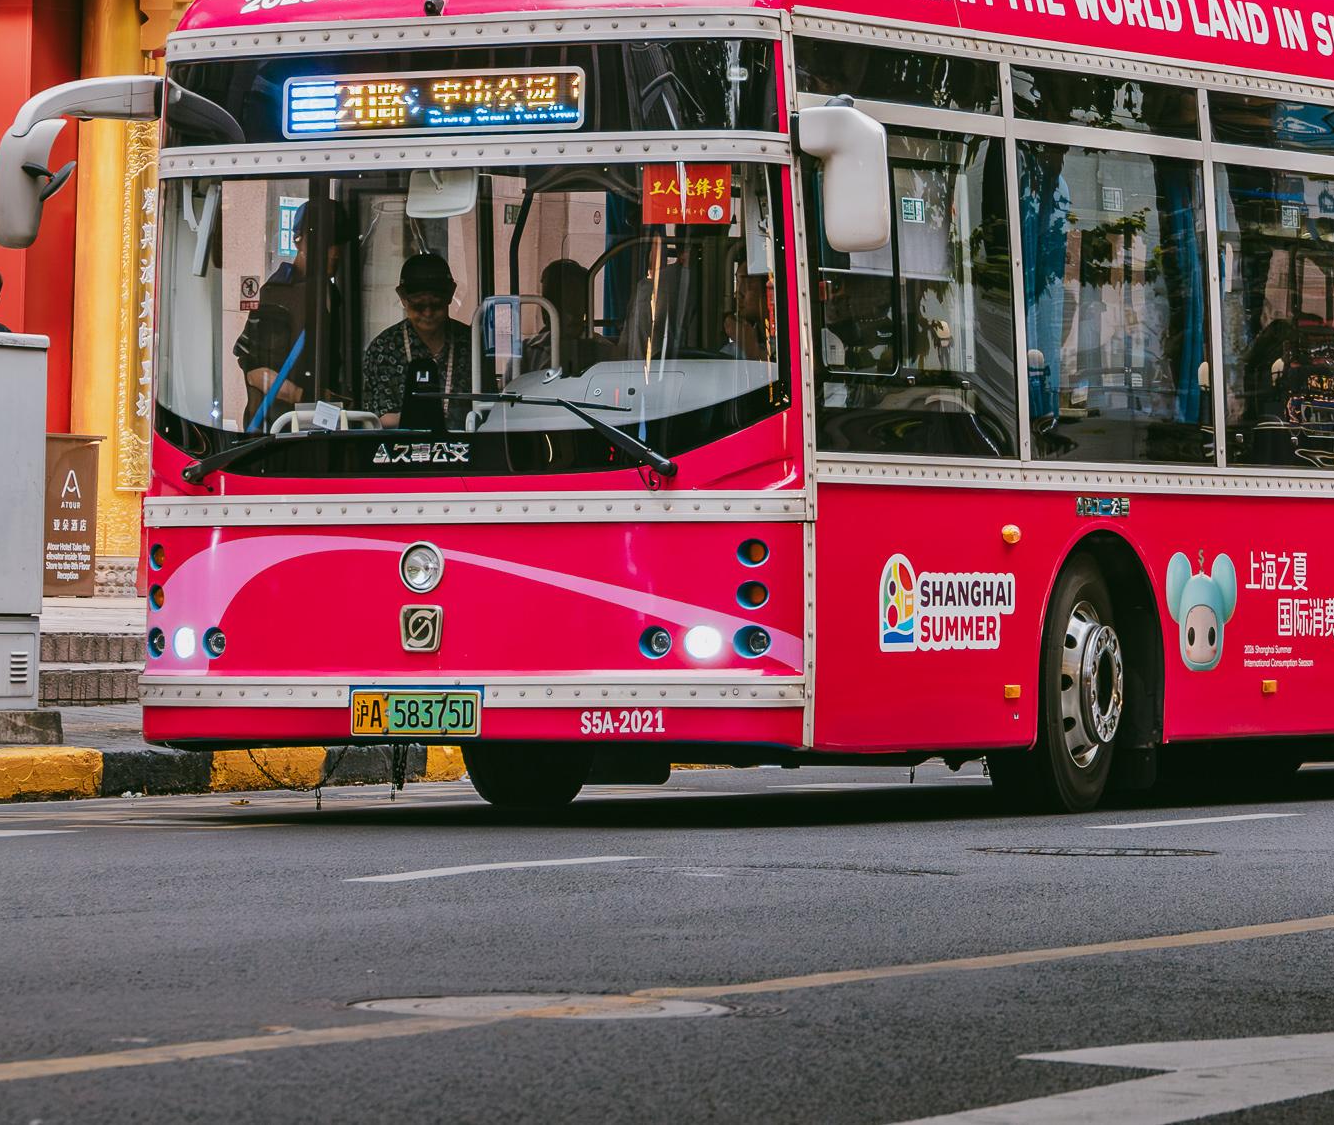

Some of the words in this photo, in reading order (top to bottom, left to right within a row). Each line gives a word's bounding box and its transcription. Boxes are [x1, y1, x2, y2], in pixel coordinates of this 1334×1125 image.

[1273, 6, 1309, 51] IN
[649, 177, 725, 200] 工人先锋号
[391, 442, 469, 463] 久事公交
[53, 519, 87, 531] 亚朵酒店
[1245, 550, 1308, 591] 上海之夏
[920, 580, 1012, 607] SHANGHAI
[920, 615, 997, 642] SUMMER
[356, 699, 383, 728] 沪A
[393, 699, 475, 729] 58375D
[580, 709, 666, 734] S5A-2021
